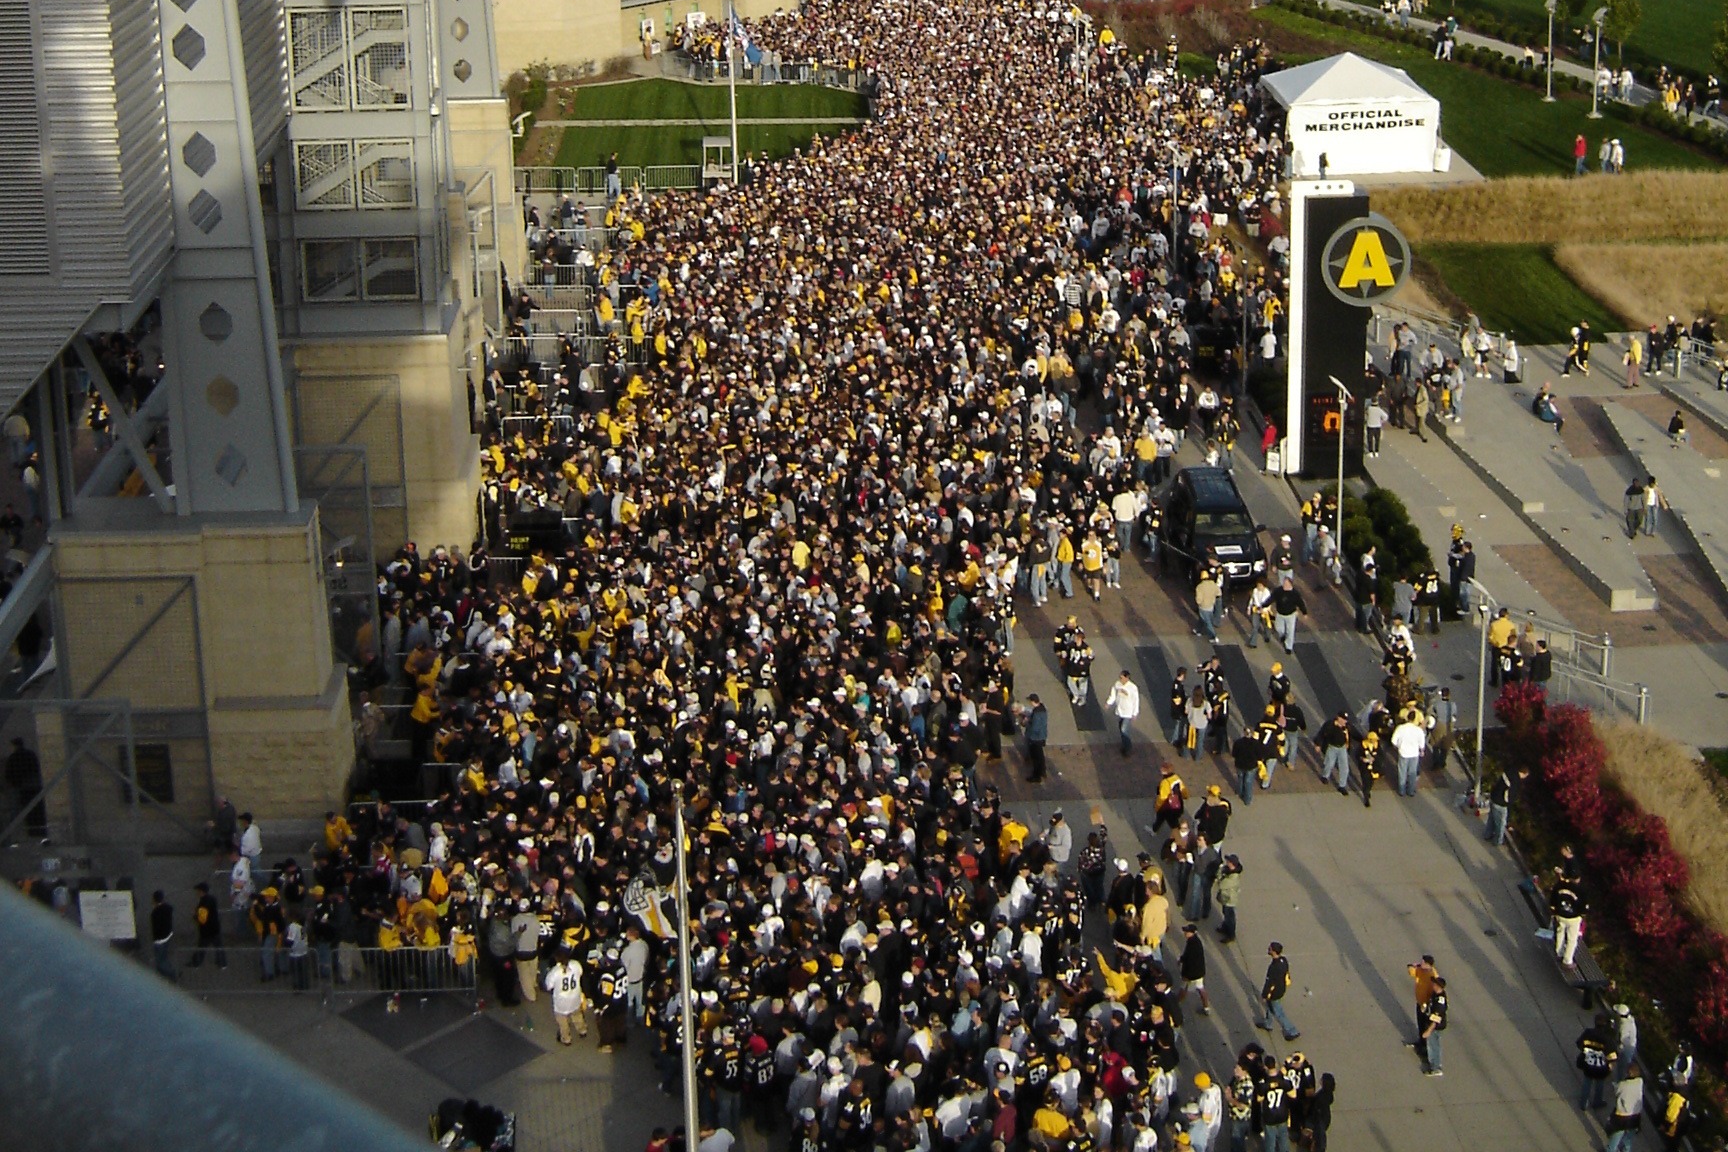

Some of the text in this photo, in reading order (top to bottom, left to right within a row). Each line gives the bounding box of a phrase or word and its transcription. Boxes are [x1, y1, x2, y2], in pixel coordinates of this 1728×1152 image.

[1328, 109, 1403, 121] OFFICIAL
[1305, 118, 1425, 133] MERCHANDISE
[1339, 230, 1396, 289] A
[1262, 728, 1273, 745] 7
[1044, 916, 1058, 936] 97
[561, 974, 577, 992] 86
[725, 1059, 739, 1080] 55
[1029, 1064, 1048, 1086] 58
[1266, 1088, 1284, 1109] 97
